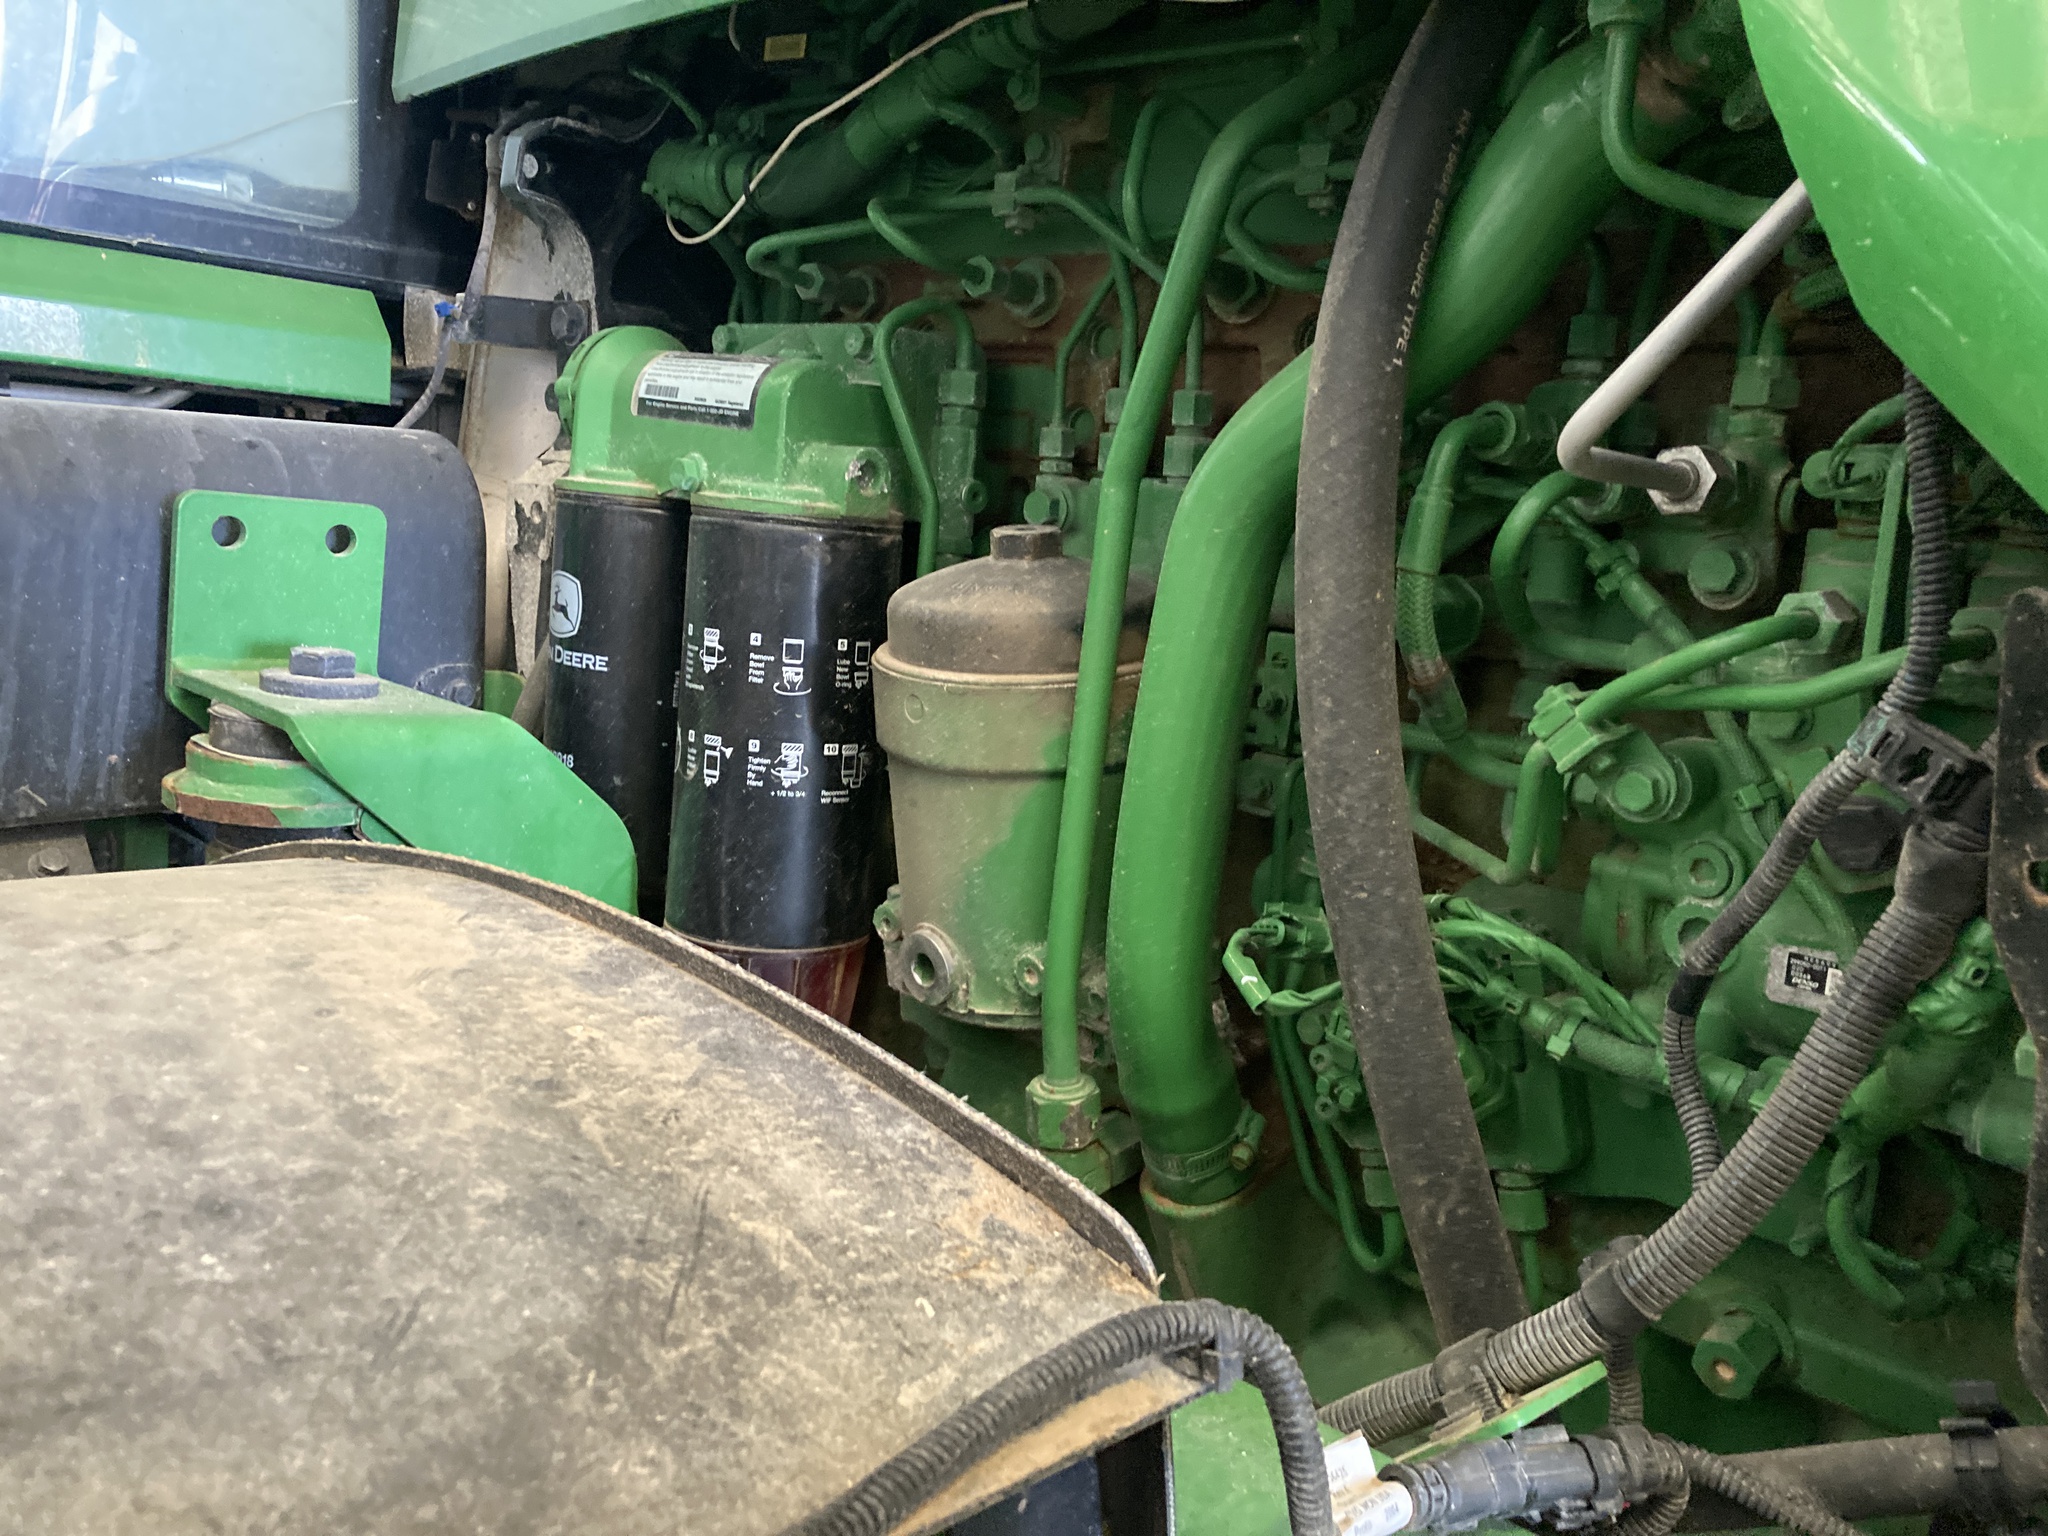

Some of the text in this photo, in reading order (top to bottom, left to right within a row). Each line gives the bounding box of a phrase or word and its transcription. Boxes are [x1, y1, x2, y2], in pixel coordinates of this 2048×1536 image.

[1396, 302, 1417, 353] TYPE
[554, 644, 608, 672] DEERE
[749, 652, 775, 662] Remove
[748, 756, 771, 765] Tighten
